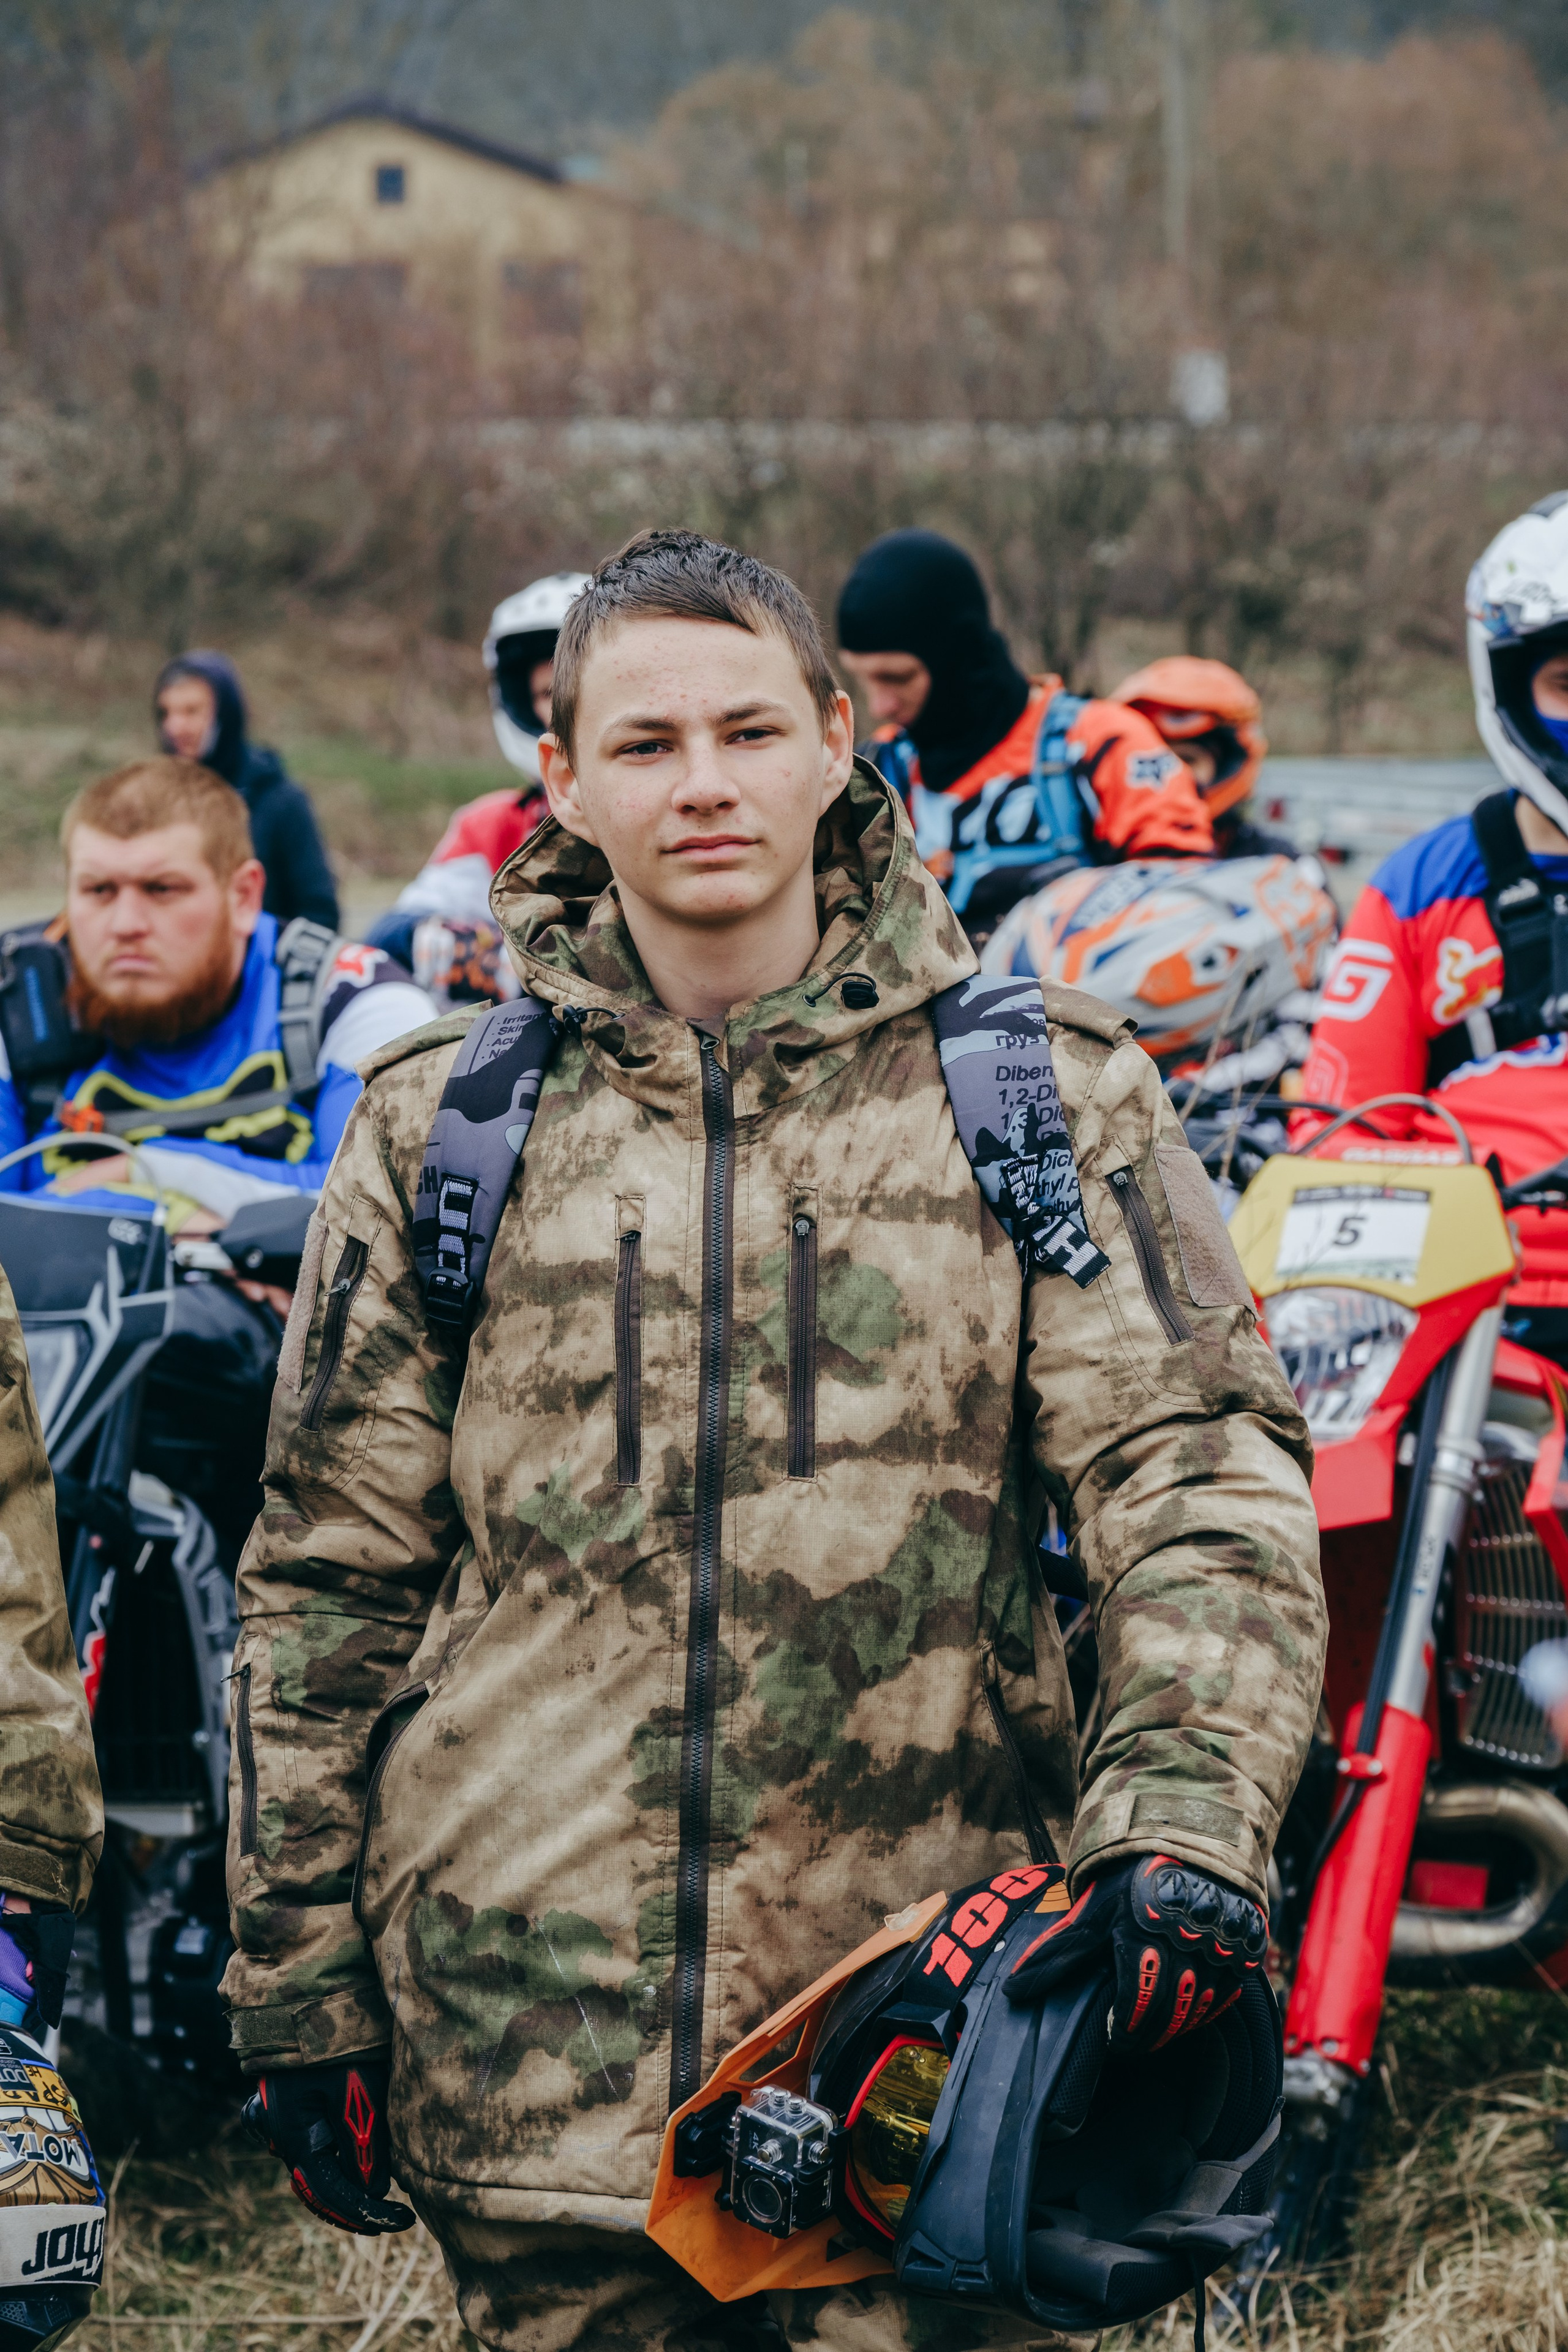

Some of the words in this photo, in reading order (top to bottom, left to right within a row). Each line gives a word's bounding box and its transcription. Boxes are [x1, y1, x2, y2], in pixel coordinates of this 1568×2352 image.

[502, 1014, 542, 1025] Irritan
[491, 1036, 521, 1046] Acu
[995, 1065, 1055, 1082] Diben
[1333, 1216, 1368, 1246] 5
[752, 2132, 760, 2150] 4K
